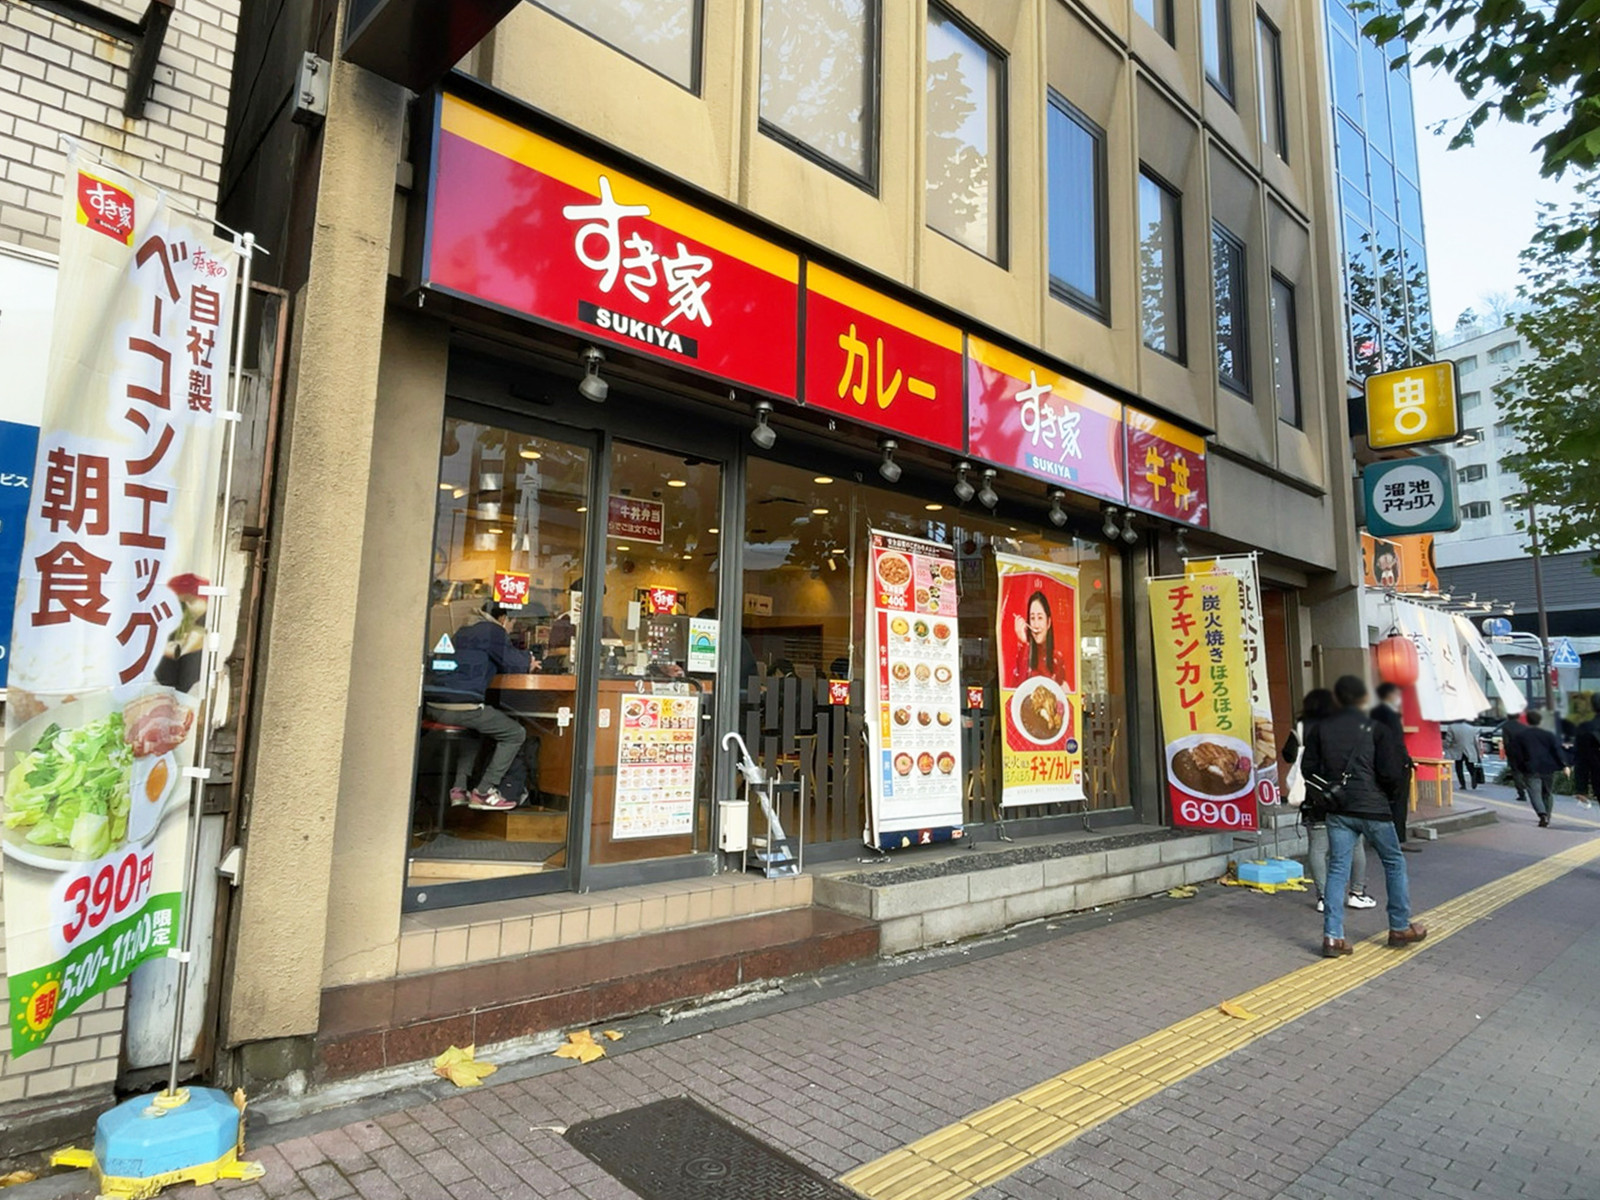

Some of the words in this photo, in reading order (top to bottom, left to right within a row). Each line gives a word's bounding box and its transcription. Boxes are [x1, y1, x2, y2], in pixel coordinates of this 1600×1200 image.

[86, 183, 132, 229] すき家
[562, 174, 713, 328] すき家
[185, 284, 220, 414] 自社製
[595, 308, 684, 353] SUKIYA
[837, 323, 937, 410] カレー
[1015, 369, 1083, 463] すき家
[115, 234, 188, 685] ベーコンエッグ
[1032, 456, 1072, 480] SUKIYA
[1145, 445, 1191, 511] 牛丼
[1384, 479, 1430, 497] 溜池
[1382, 493, 1436, 513] アネックス
[30, 446, 113, 628] 朝食
[1168, 585, 1204, 731] チキンカレー
[1201, 594, 1226, 663] 炭火焼き
[1209, 665, 1233, 731] ほろほろ
[1031, 756, 1079, 781] チキンカレー
[1181, 800, 1253, 827] 690円
[62, 852, 154, 943] 390円
[152, 908, 172, 947] 限定
[34, 987, 57, 1025] 朝
